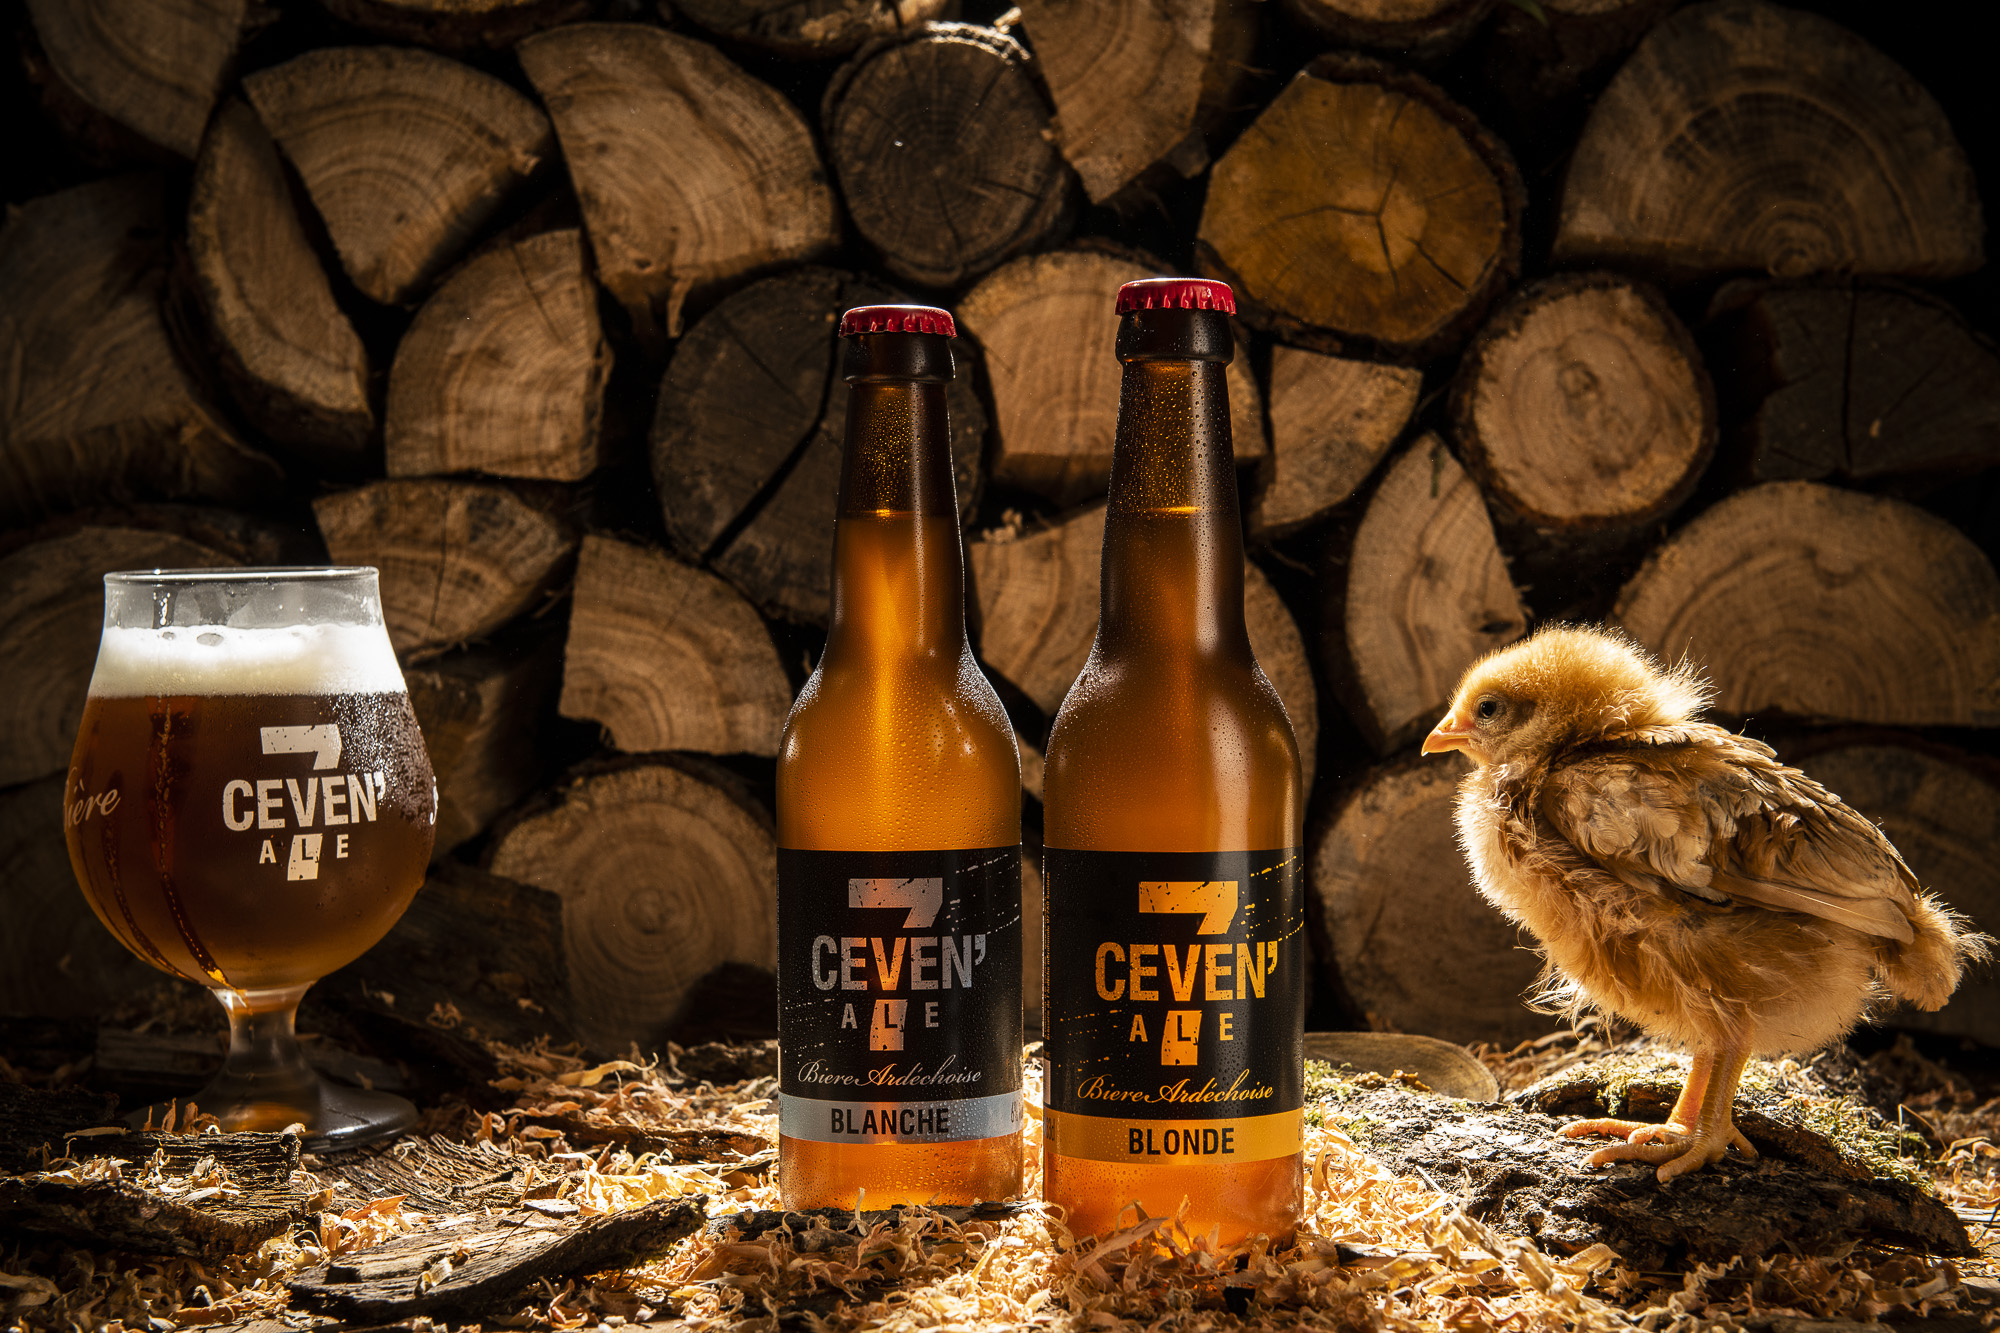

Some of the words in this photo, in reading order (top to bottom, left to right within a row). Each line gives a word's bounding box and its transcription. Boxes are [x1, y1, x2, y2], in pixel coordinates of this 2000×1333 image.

[260, 723, 342, 770] 7
[848, 877, 944, 929] 7
[1138, 880, 1239, 935] 7
[855, 1054, 982, 1087] Ardéchoise
[1145, 1068, 1274, 1104] Ardéchoise
[830, 1107, 950, 1136] BLANCHE
[1128, 1127, 1235, 1156] BLONDE
